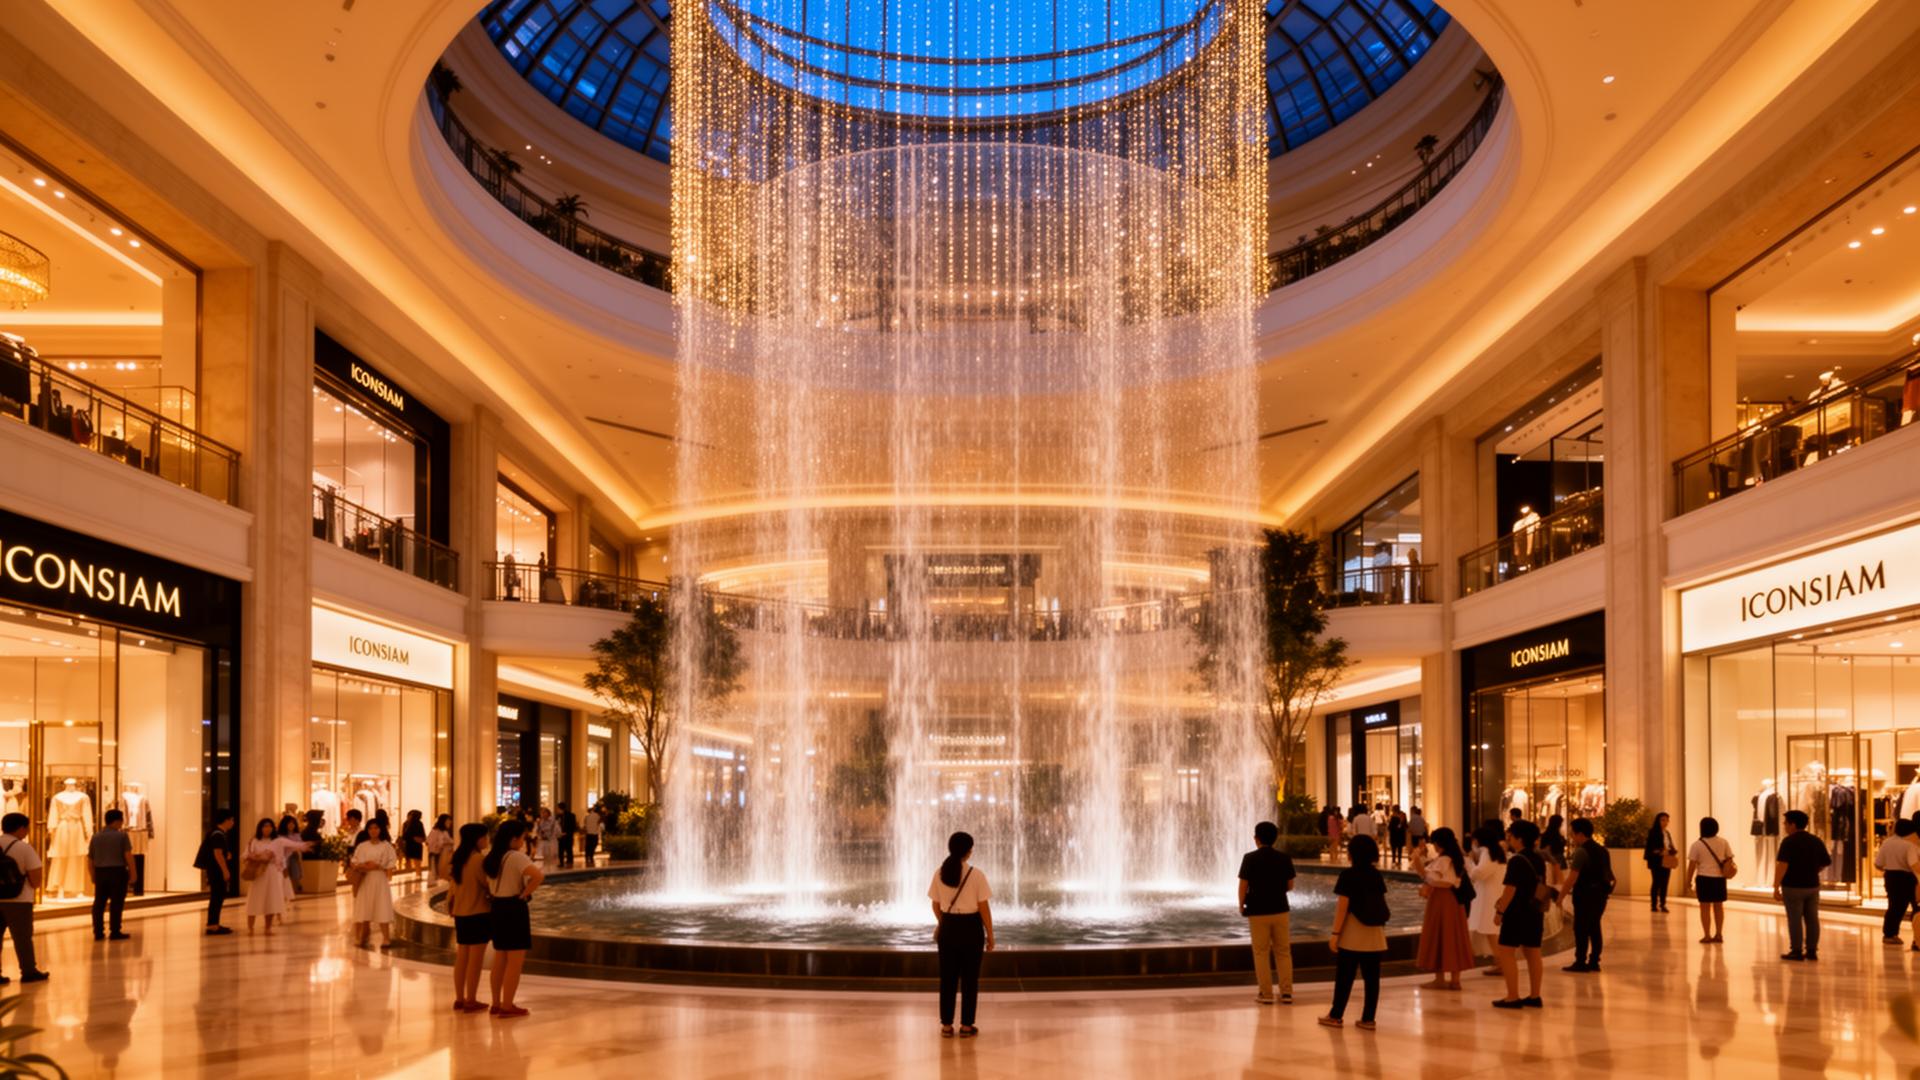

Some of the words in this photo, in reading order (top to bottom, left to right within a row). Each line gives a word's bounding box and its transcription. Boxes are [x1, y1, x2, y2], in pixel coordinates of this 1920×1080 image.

[351, 362, 404, 411] ICONSIAM
[1741, 560, 1885, 622] ICONSIAM
[349, 635, 409, 665] ICONSIAM
[1511, 638, 1569, 668] ICONSIAM
